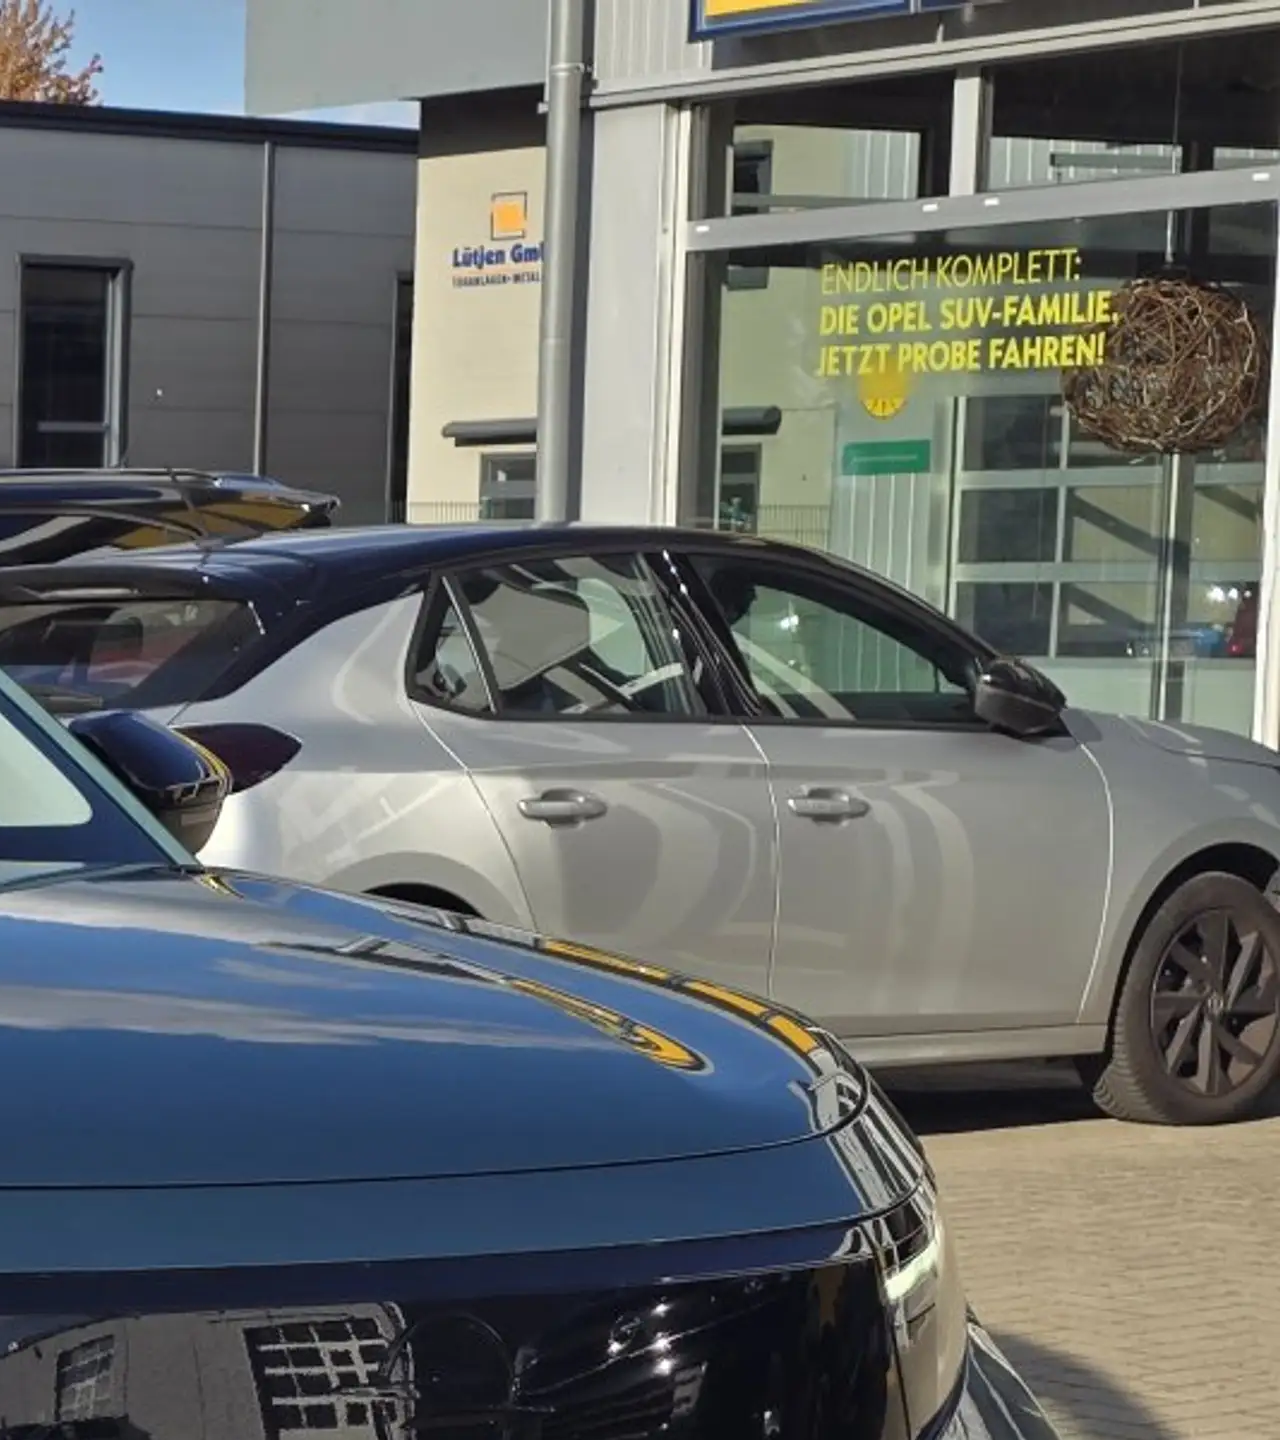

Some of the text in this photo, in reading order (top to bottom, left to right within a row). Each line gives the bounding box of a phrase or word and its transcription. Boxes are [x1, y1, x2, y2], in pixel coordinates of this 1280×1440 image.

[452, 244, 506, 270] Lütjen
[821, 248, 1083, 295] ENDLICH KOMPLETT:
[819, 304, 860, 336] DIE
[866, 299, 933, 333] OPEL
[817, 331, 1106, 378] JETZT PROBE FAHREN!
